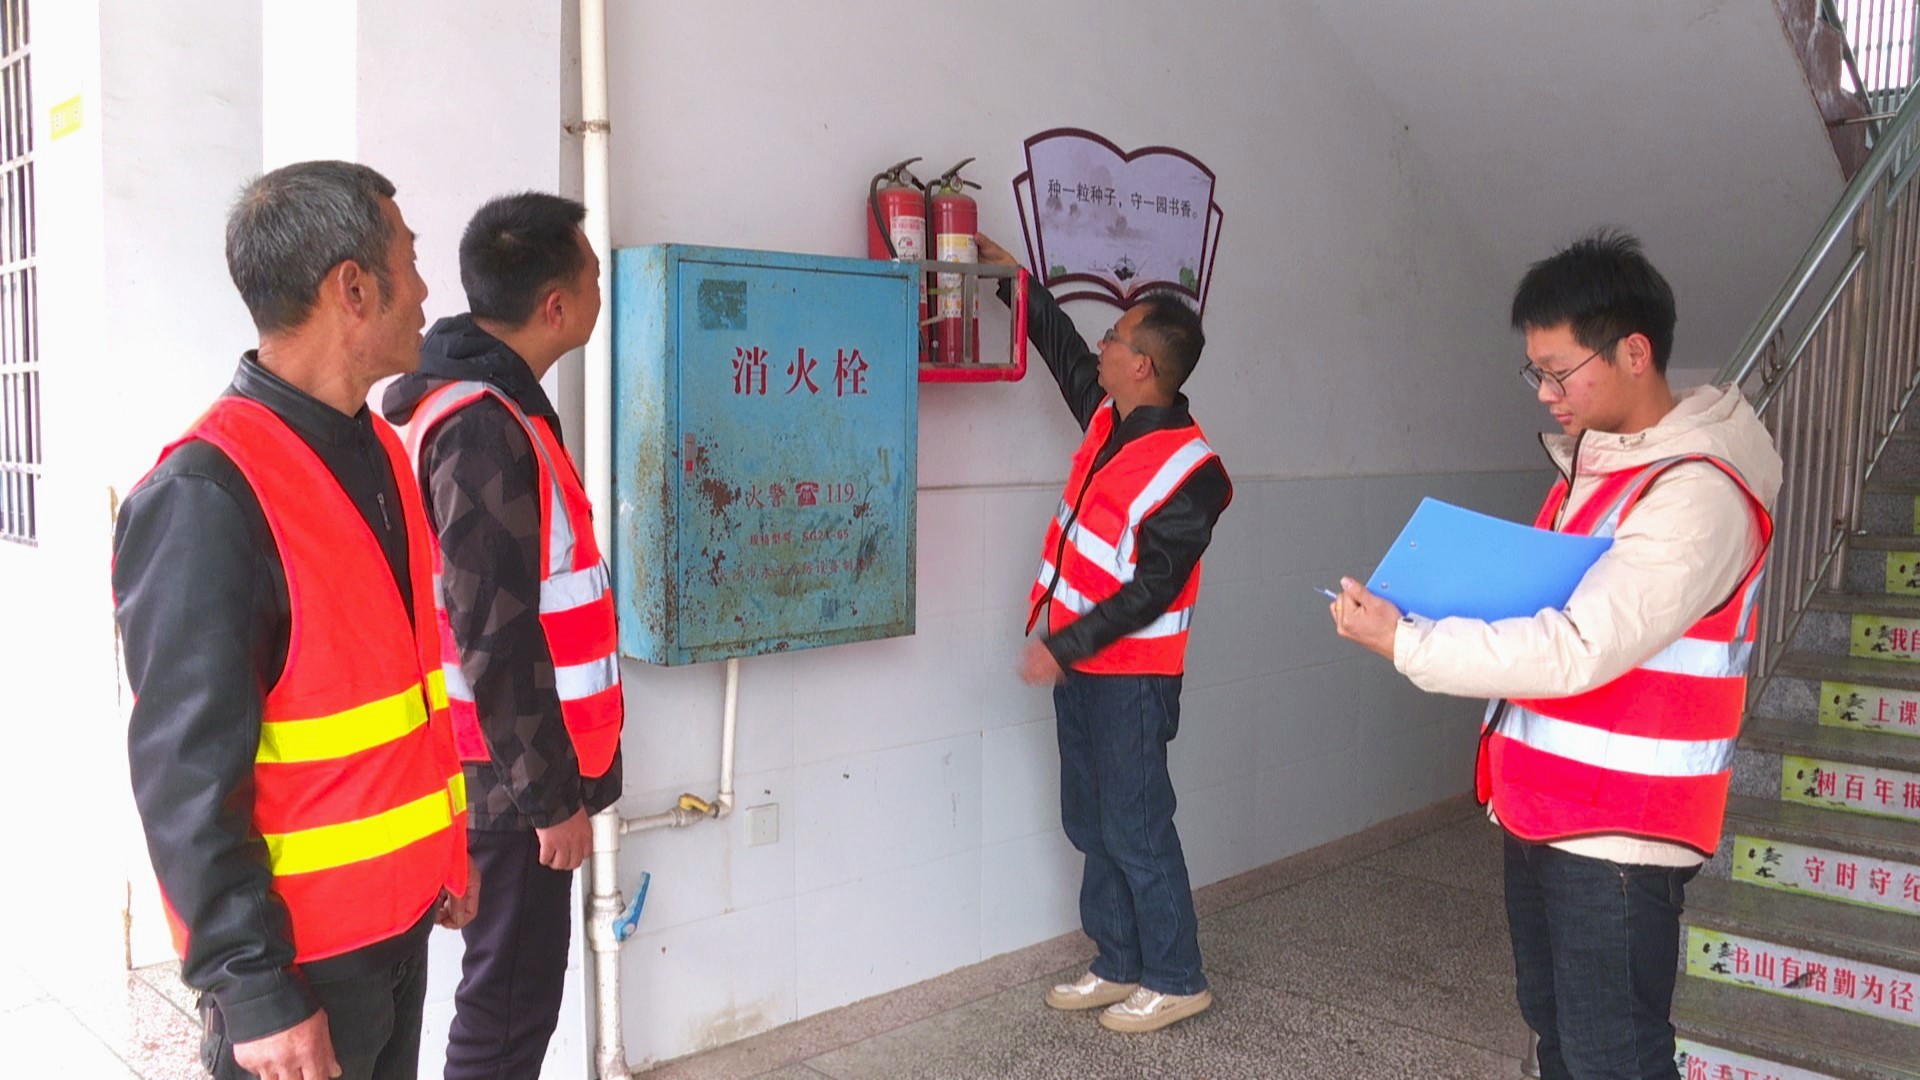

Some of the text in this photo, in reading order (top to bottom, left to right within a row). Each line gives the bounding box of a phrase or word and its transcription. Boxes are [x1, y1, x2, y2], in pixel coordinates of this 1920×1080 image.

[1047, 178, 1199, 219] 种一粒种子，守一园书香。
[731, 345, 869, 397] 消火栓
[747, 482, 855, 509] 火警 119
[1872, 697, 1919, 726] 上课
[1804, 856, 1920, 904] 守时守纪
[1731, 942, 1914, 1013] 书山有路勤为径
